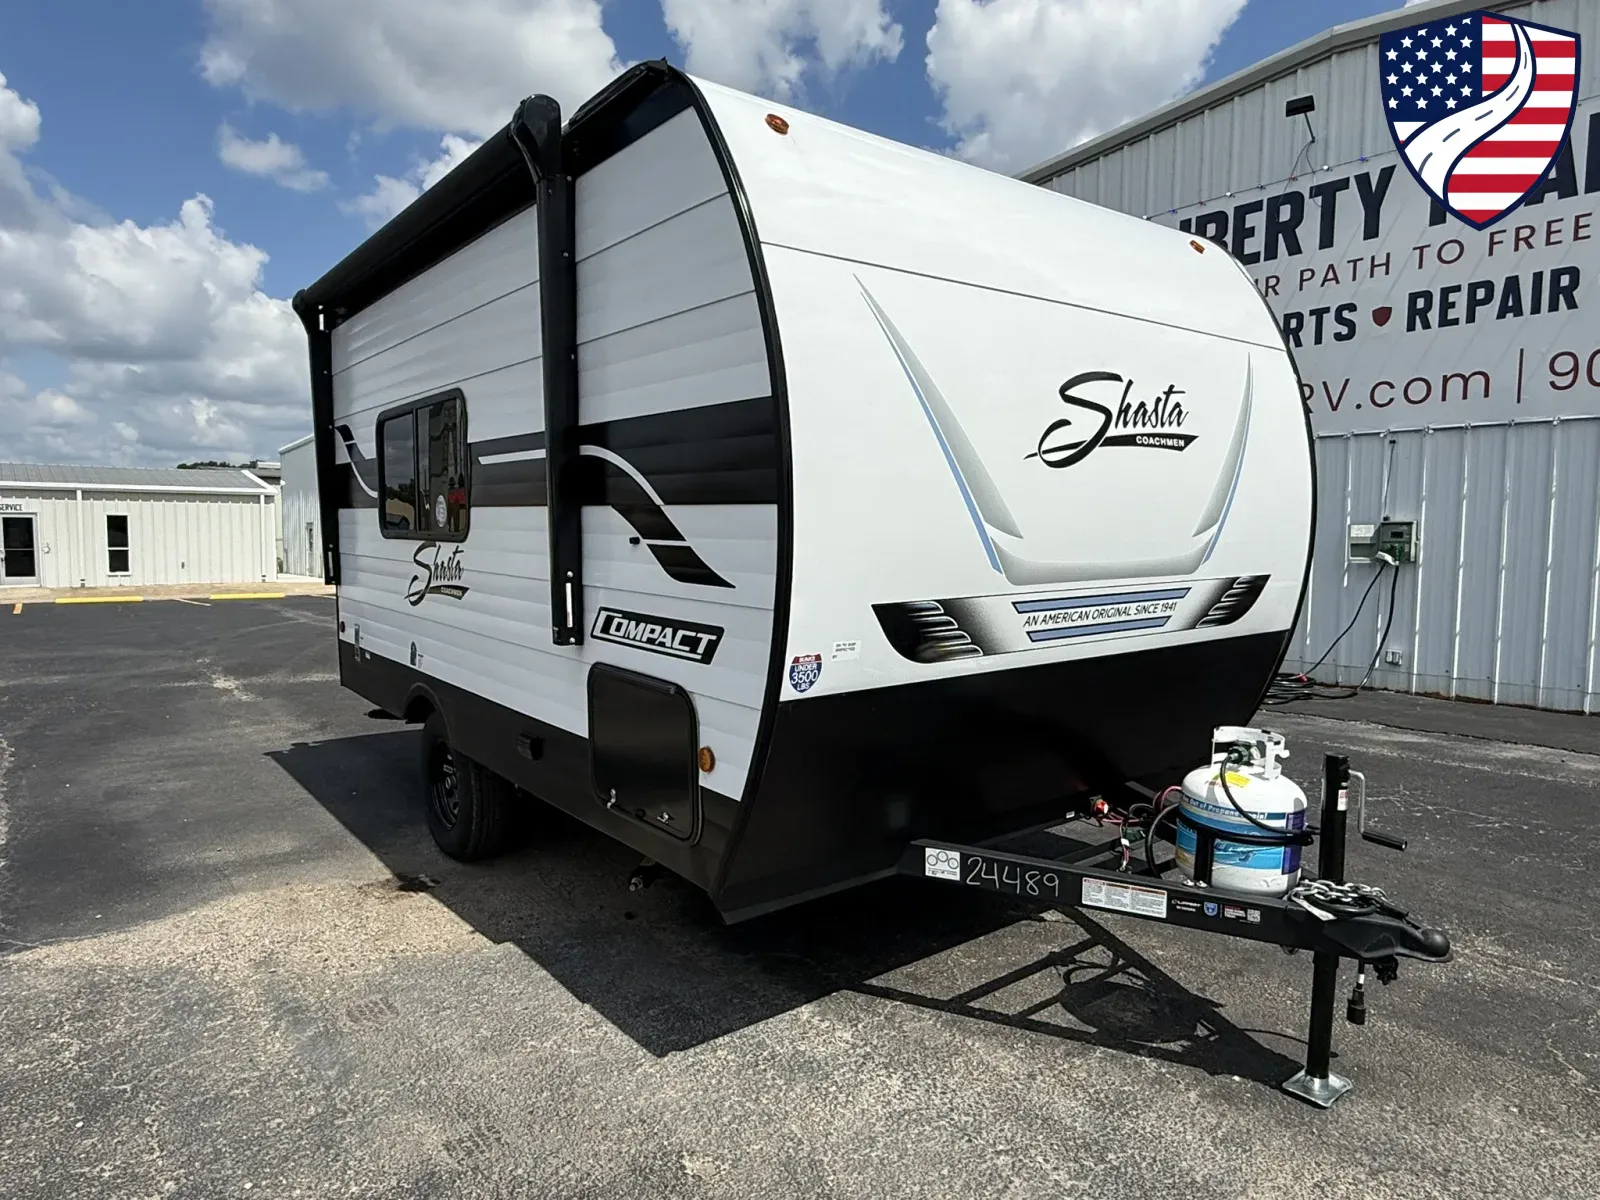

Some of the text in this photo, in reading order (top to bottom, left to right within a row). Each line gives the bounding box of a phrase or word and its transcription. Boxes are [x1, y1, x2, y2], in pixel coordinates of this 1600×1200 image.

[1179, 164, 1397, 266] BERTY
[1299, 252, 1391, 291] PATH
[1412, 239, 1465, 270] TO
[1488, 212, 1593, 257] FREE
[1406, 265, 1581, 333] REPAIR
[1038, 371, 1190, 469] Shasta
[1135, 435, 1185, 447] COACHMEN
[407, 540, 465, 607] Shasta
[592, 610, 718, 660] COMPACT
[1022, 601, 1178, 628] AN AMERICAN ORIGINAL SINCE 1941
[791, 670, 819, 685] 3500
[794, 663, 818, 672] UNDER
[796, 682, 811, 691] LBS
[1207, 803, 1240, 817] Propane
[966, 856, 1060, 898] 24489
